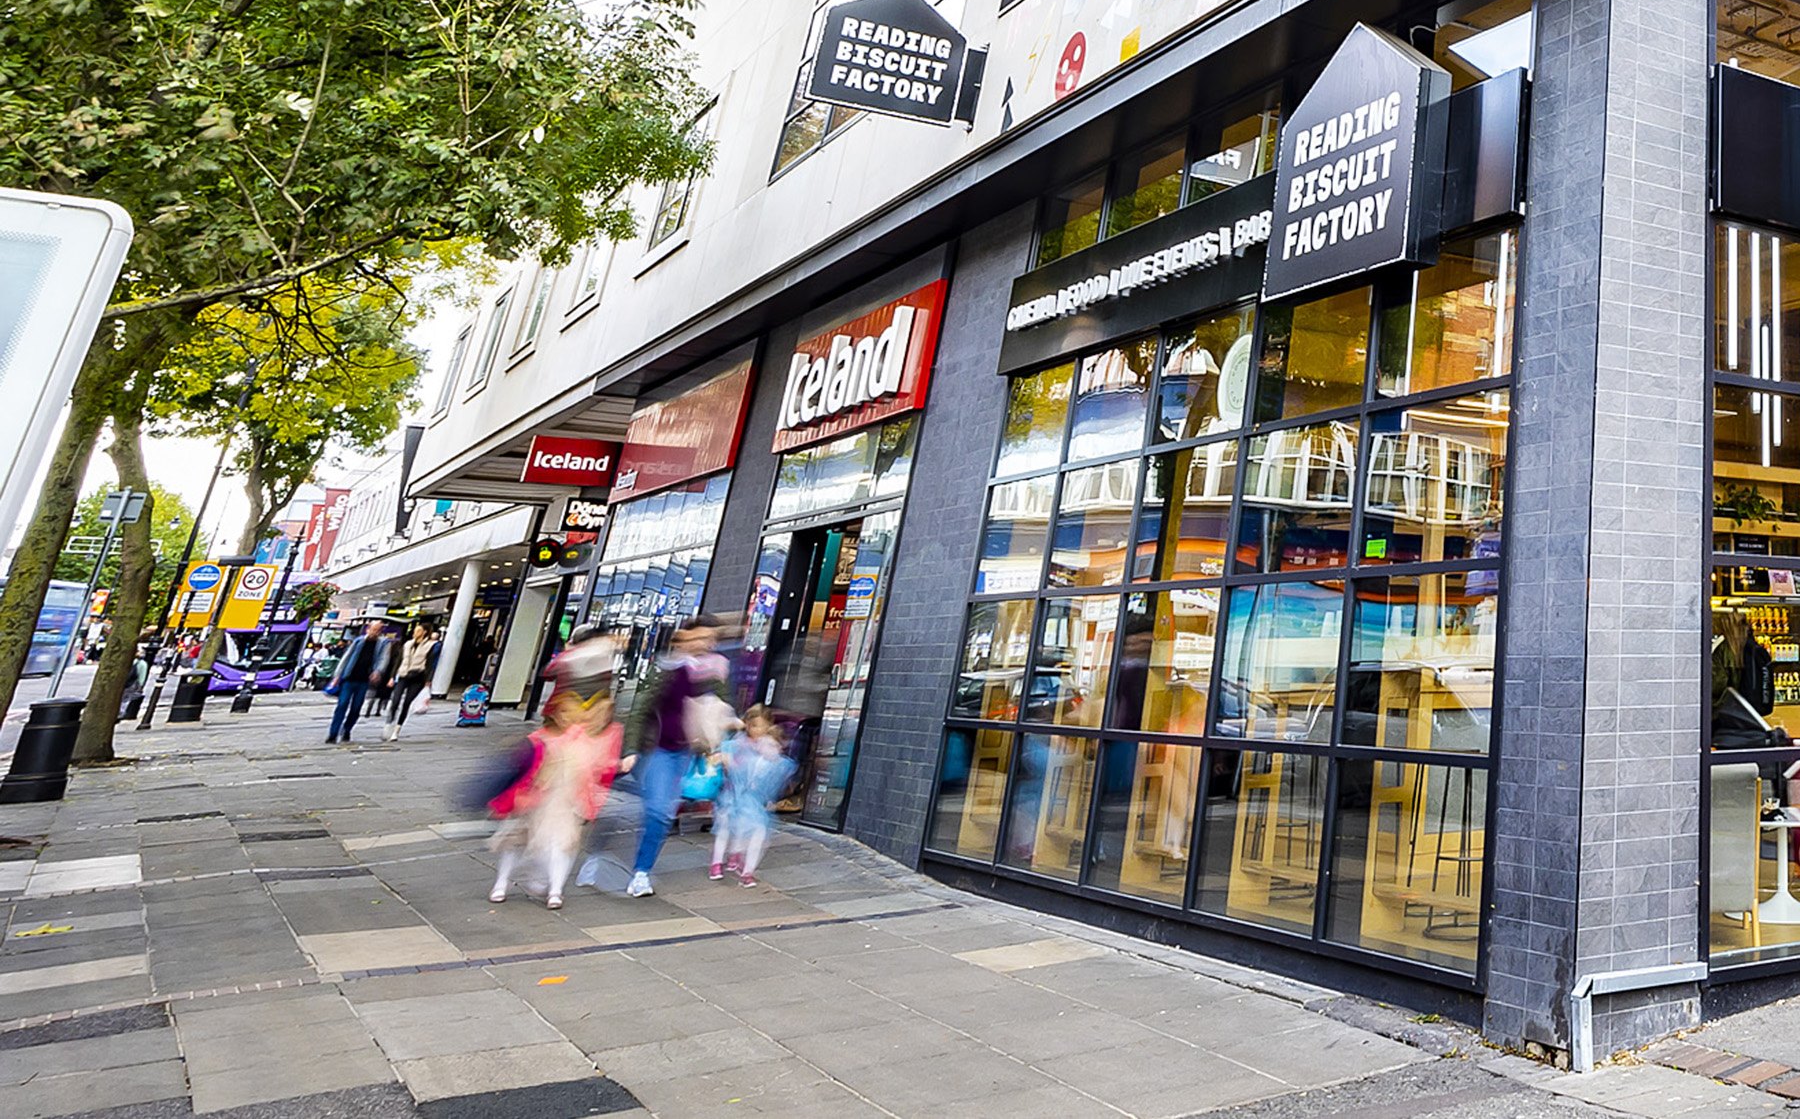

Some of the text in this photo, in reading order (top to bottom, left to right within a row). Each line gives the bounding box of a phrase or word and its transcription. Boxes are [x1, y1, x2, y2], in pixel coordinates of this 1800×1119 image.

[841, 16, 952, 59] READING
[835, 40, 948, 81] BISCUIT
[830, 64, 943, 105] FACTORY
[1293, 91, 1400, 166] READING
[1288, 139, 1397, 214] BISCUIT
[1282, 188, 1394, 261] FACTORY
[776, 305, 915, 430] Iceland
[533, 450, 610, 472] Iceland
[237, 590, 262, 598] ZONE
[247, 574, 265, 585] 20
